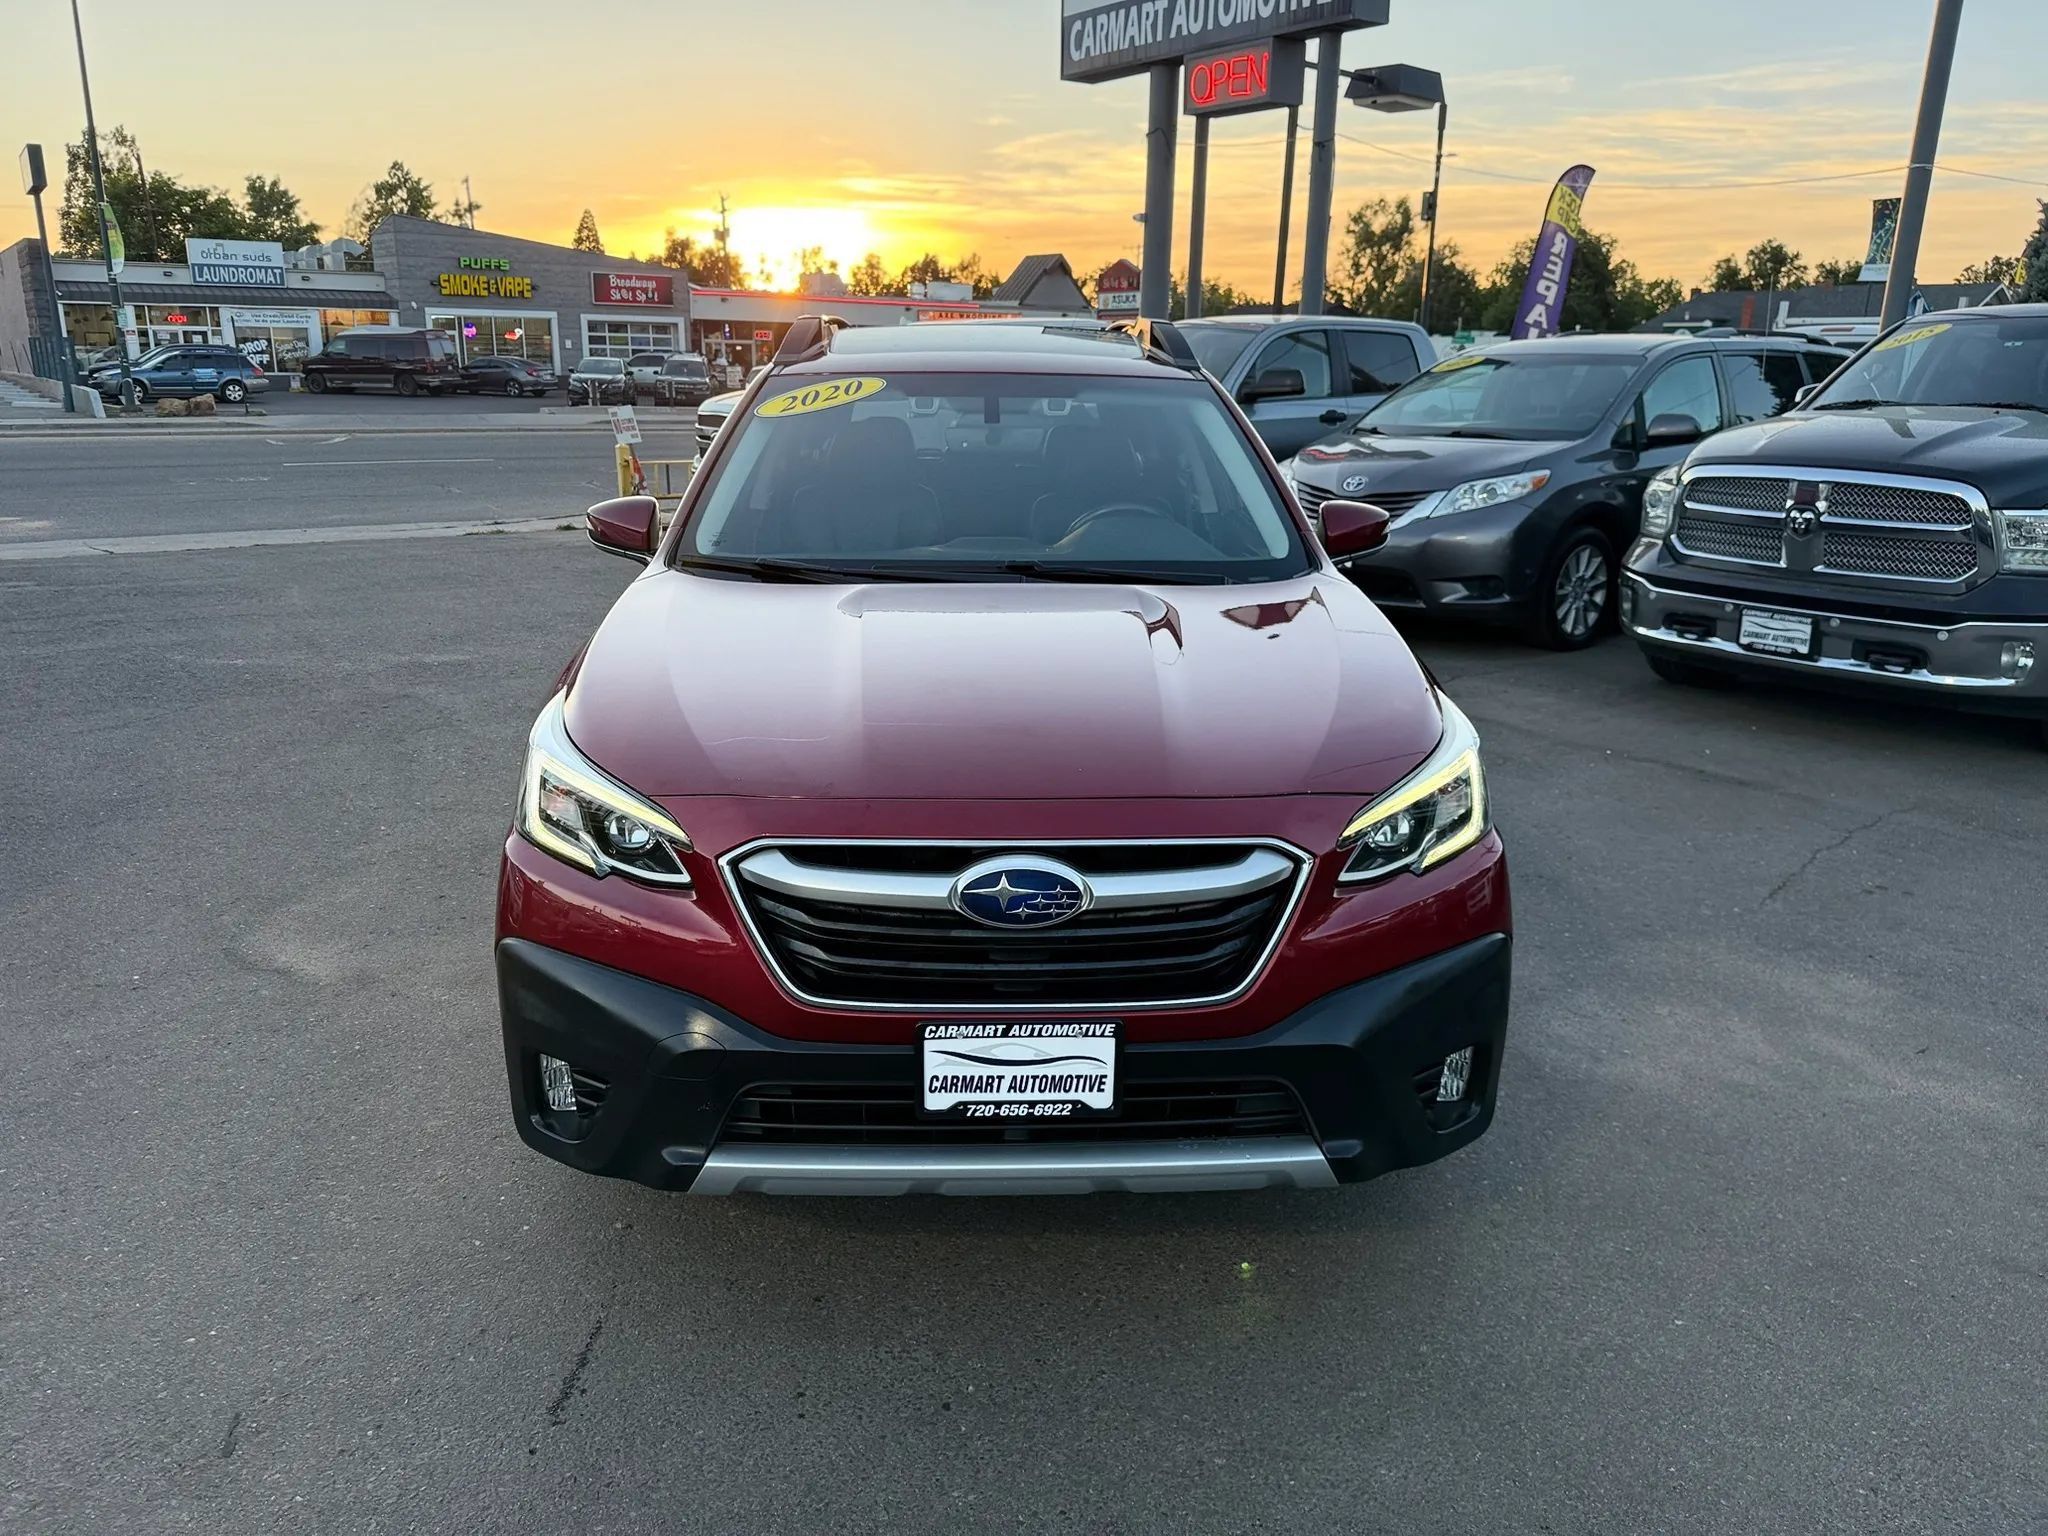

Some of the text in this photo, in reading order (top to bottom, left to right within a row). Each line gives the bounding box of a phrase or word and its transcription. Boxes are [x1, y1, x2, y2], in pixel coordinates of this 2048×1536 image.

[1069, 1, 1168, 62] CARMART
[1190, 52, 1269, 103] OPEN
[242, 253, 272, 262] suds
[459, 256, 510, 270] PUFFS
[195, 266, 281, 284] LAUNDROMAT
[609, 275, 657, 289] Broadways
[440, 273, 532, 298] SMOKE & VAPE
[239, 340, 269, 354] DROP
[779, 380, 863, 413] 2020
[1742, 630, 1771, 641] CARMART
[924, 1024, 1115, 1038] CARMART AUTOMOTIVE
[928, 1074, 1108, 1093] CARMART AUTOMOTIVE
[966, 1104, 1072, 1116] 720-656-6922
